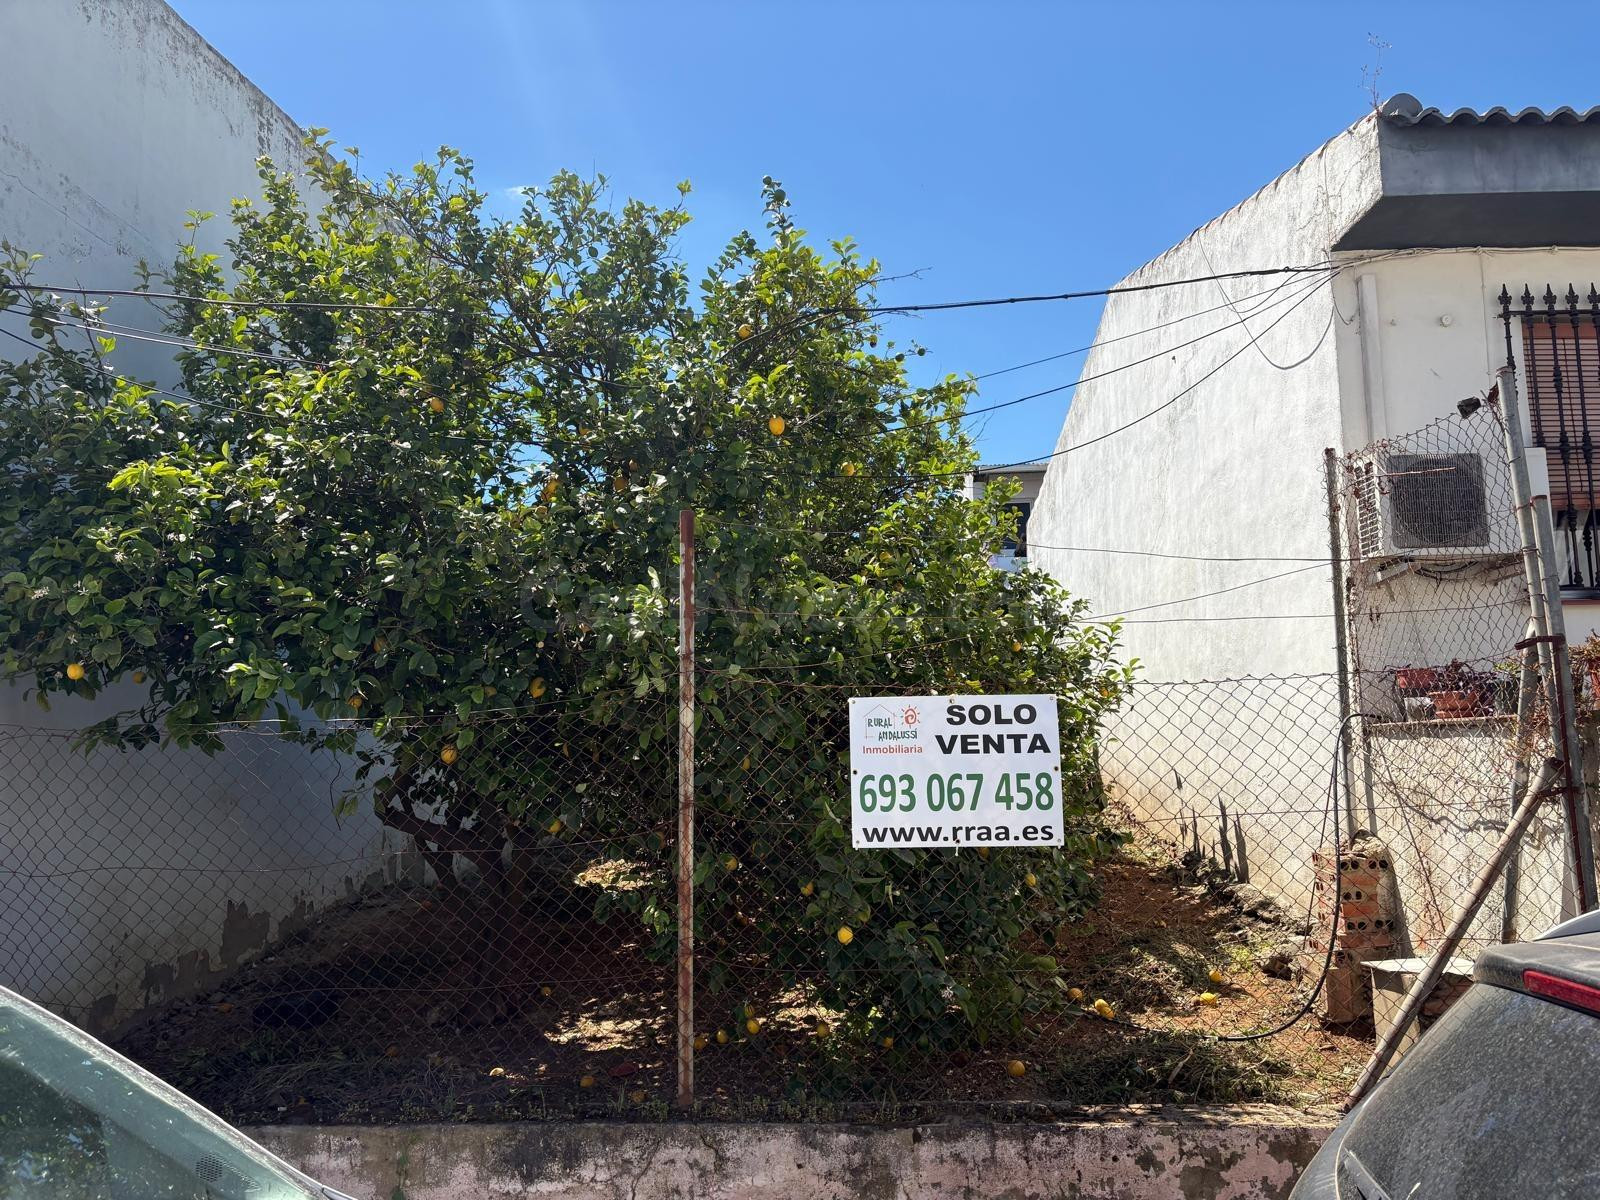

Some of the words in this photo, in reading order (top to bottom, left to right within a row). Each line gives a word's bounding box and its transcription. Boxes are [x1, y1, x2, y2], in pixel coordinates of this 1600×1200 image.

[867, 717, 893, 729] RURAL
[945, 703, 1037, 726] SOLO
[862, 744, 923, 755] Inmobiliaria
[935, 733, 1051, 755] VENTA
[859, 773, 917, 813] 693
[926, 772, 984, 812] 067
[994, 771, 1055, 811] 458
[861, 824, 1054, 843] www.rraa.es
